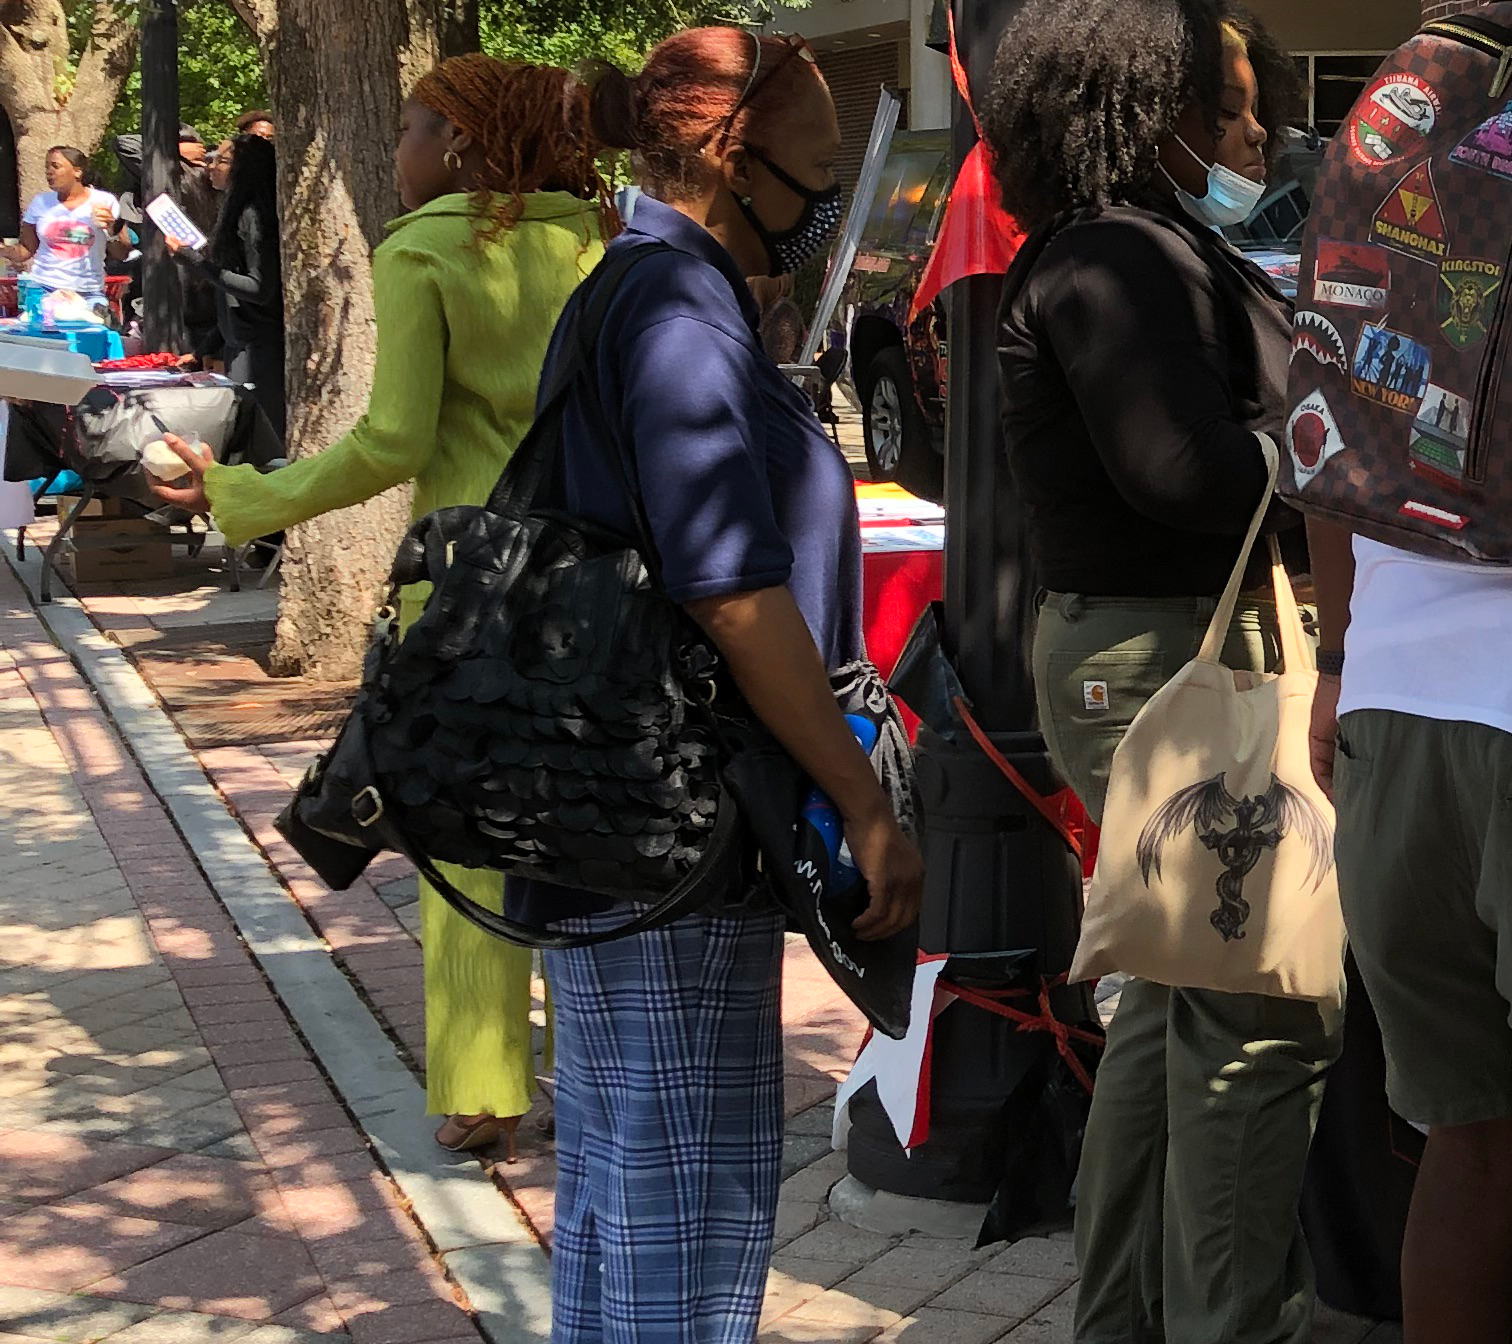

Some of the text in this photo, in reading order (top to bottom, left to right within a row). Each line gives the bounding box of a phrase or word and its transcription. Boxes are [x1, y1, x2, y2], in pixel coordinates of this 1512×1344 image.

[1375, 220, 1446, 257] SHANGHAI
[1320, 283, 1384, 302] MONACO
[1353, 379, 1379, 399] NEW
[1300, 402, 1325, 416] OSAKA
